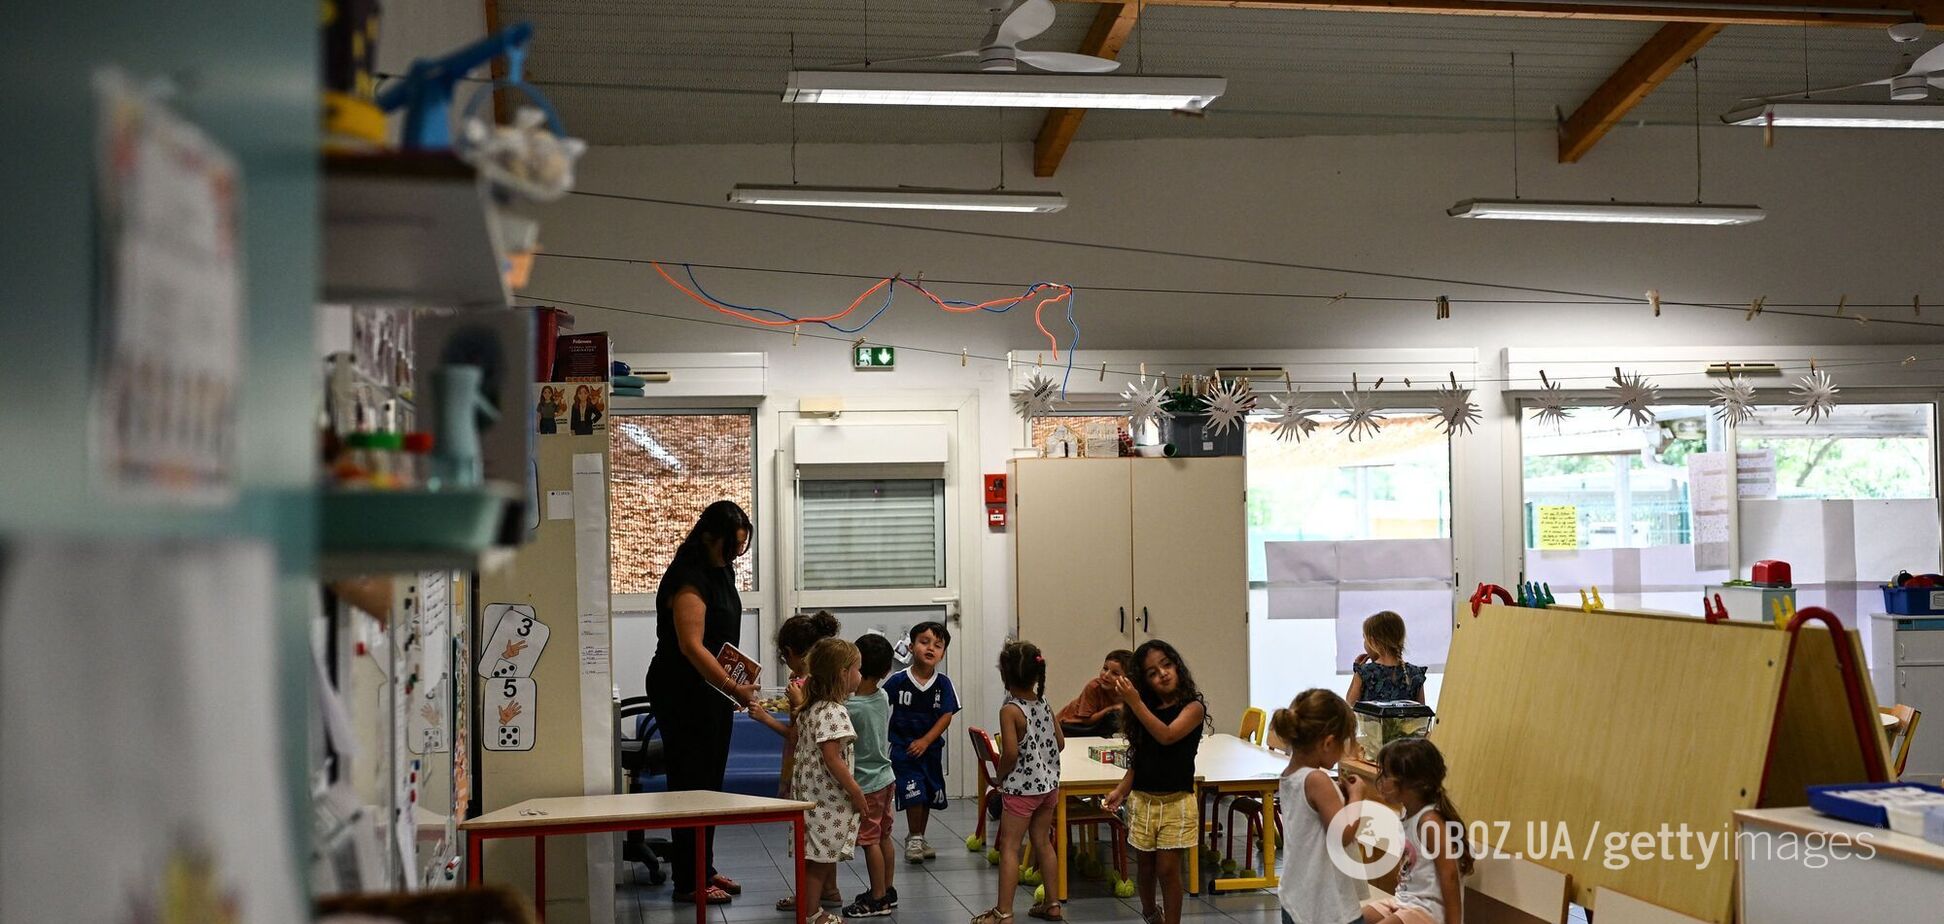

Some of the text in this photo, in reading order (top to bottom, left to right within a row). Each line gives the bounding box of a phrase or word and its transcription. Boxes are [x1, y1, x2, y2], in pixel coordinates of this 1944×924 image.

[517, 618, 533, 636] 3
[503, 679, 517, 698] 5
[898, 690, 913, 706] 10
